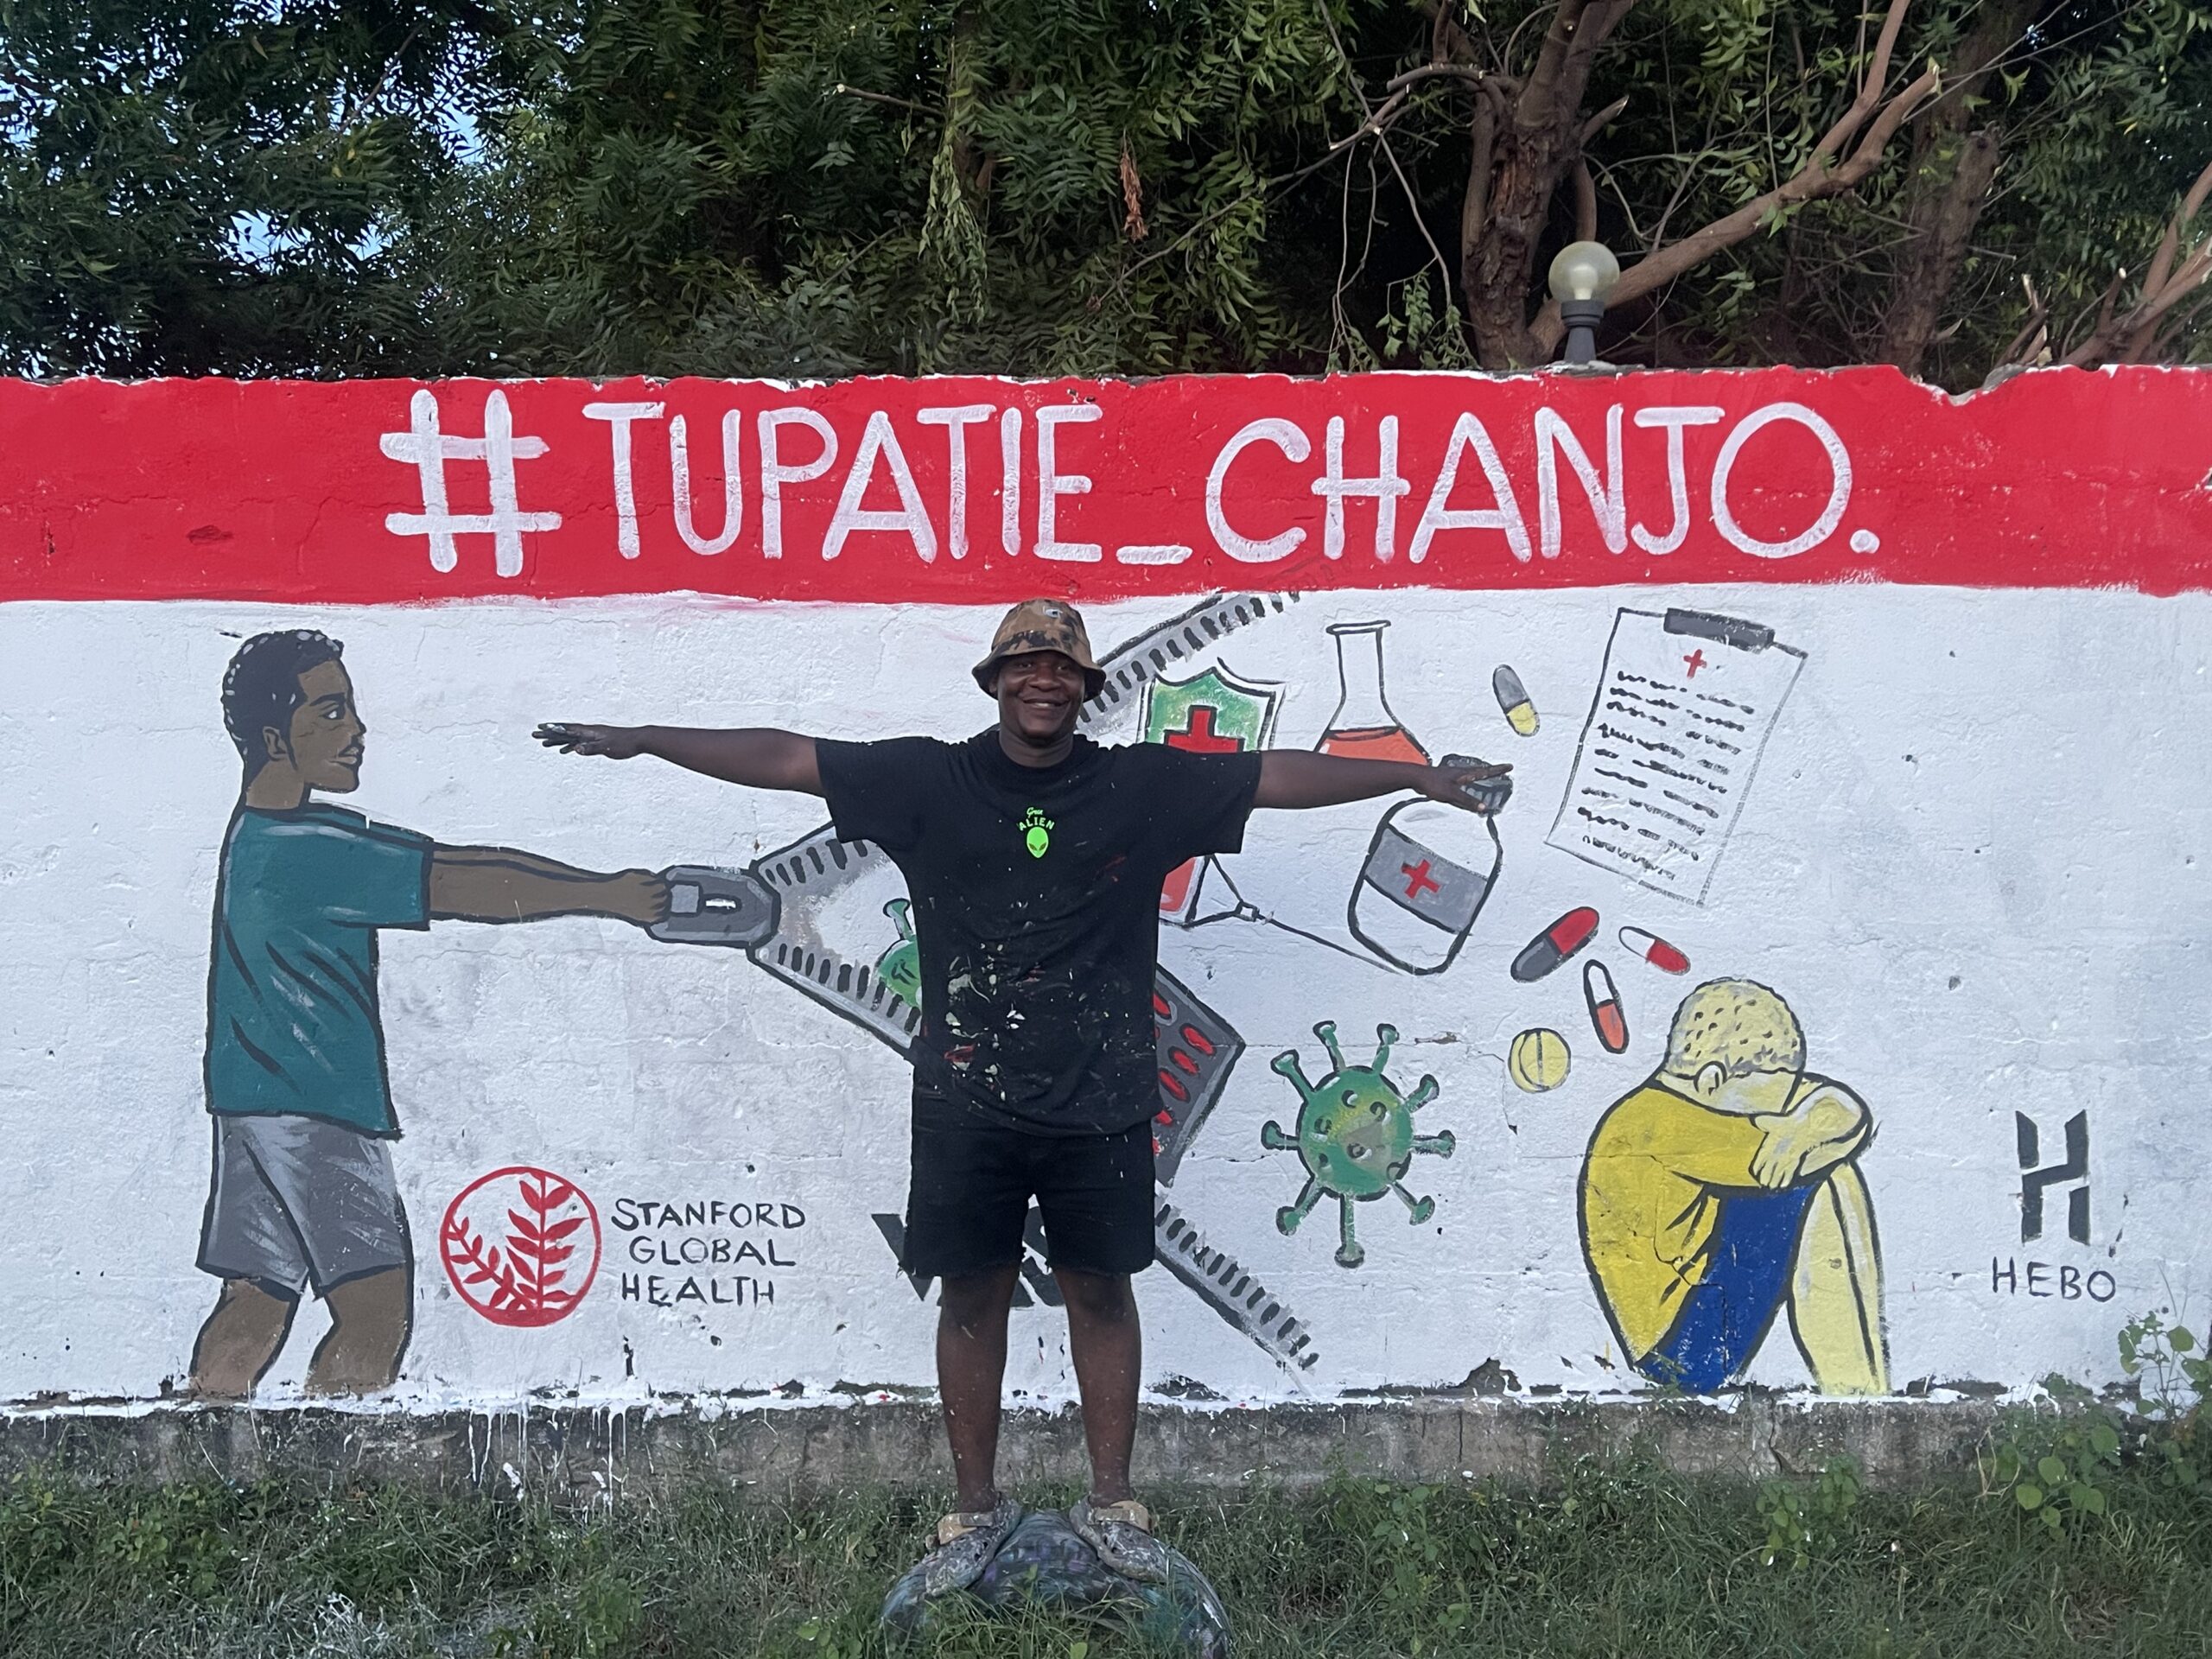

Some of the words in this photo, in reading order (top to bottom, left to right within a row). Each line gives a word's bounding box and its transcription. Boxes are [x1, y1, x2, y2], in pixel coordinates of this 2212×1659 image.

[1019, 817, 1055, 830] ALIEN
[611, 1198, 806, 1231] STANFORD
[628, 1236, 797, 1267] GLOBAL
[620, 1272, 775, 1307] HEALTH
[1993, 1256, 2116, 1302] HEBO
